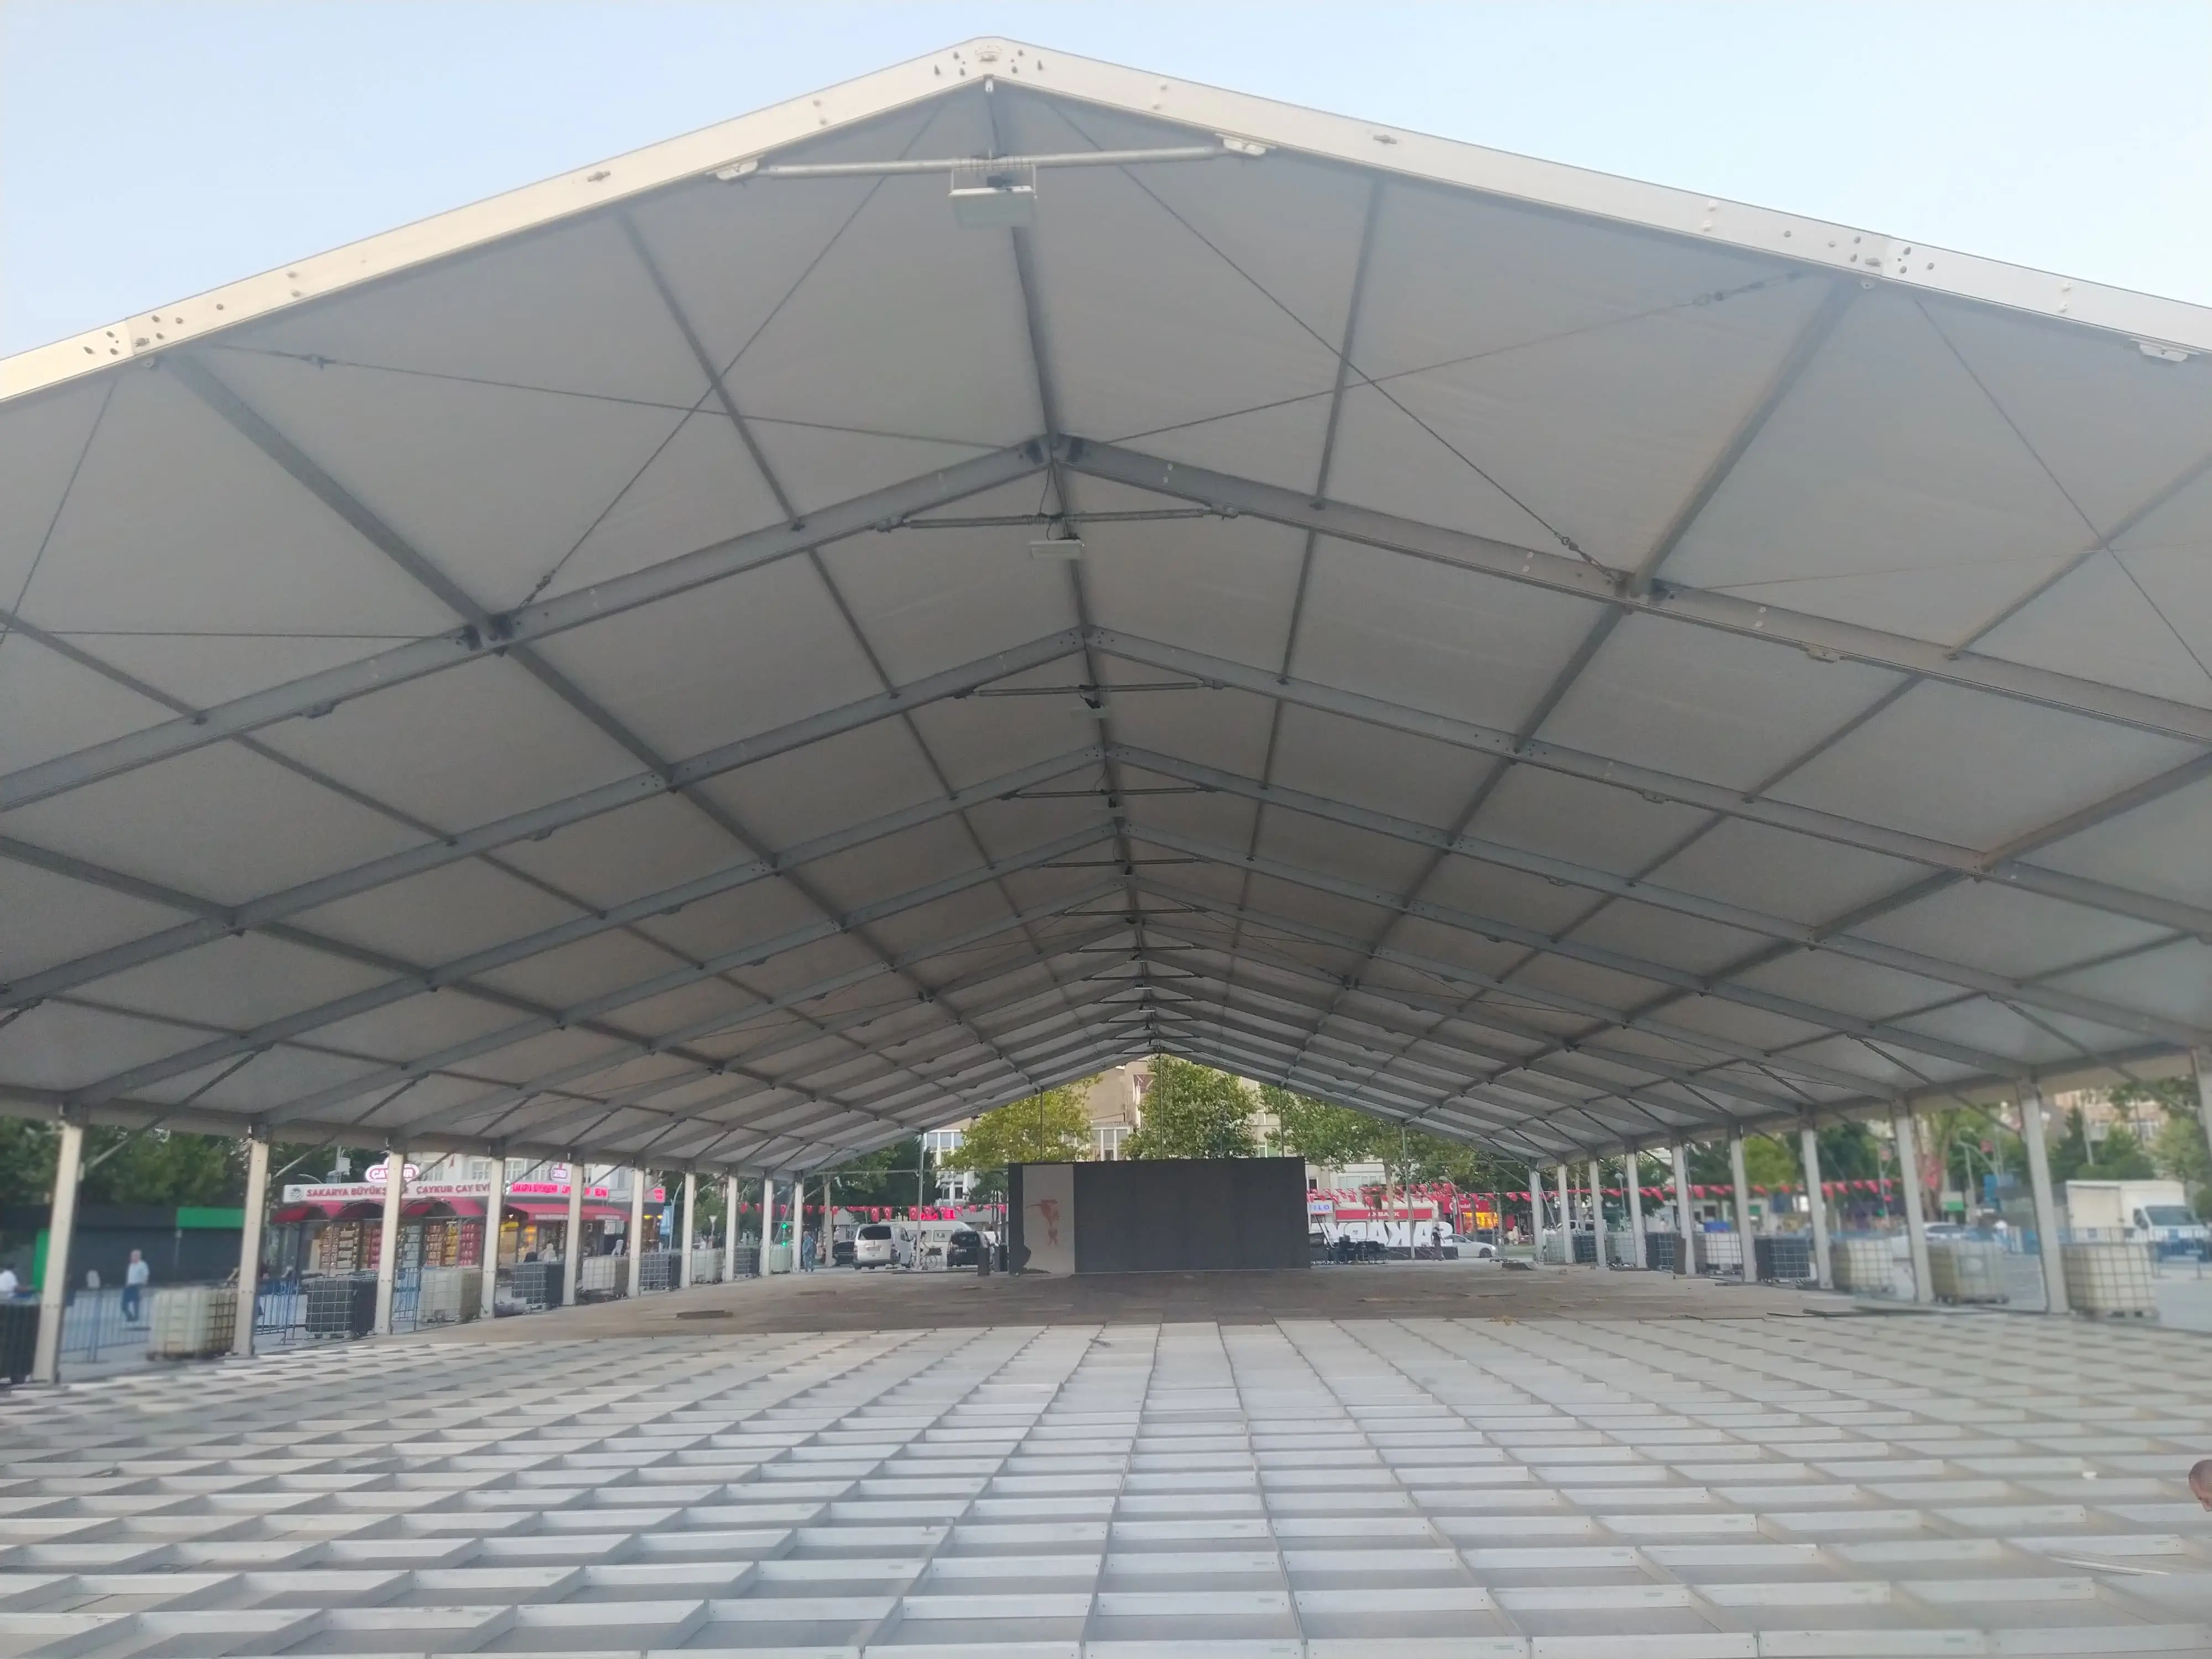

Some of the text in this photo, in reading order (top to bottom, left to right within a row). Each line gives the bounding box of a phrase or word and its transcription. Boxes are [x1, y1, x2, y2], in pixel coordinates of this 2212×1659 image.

[307, 1188, 348, 1197] SAKARYA
[416, 1185, 453, 1194] ÇAYKUR
[455, 1184, 473, 1193] ÇAY
